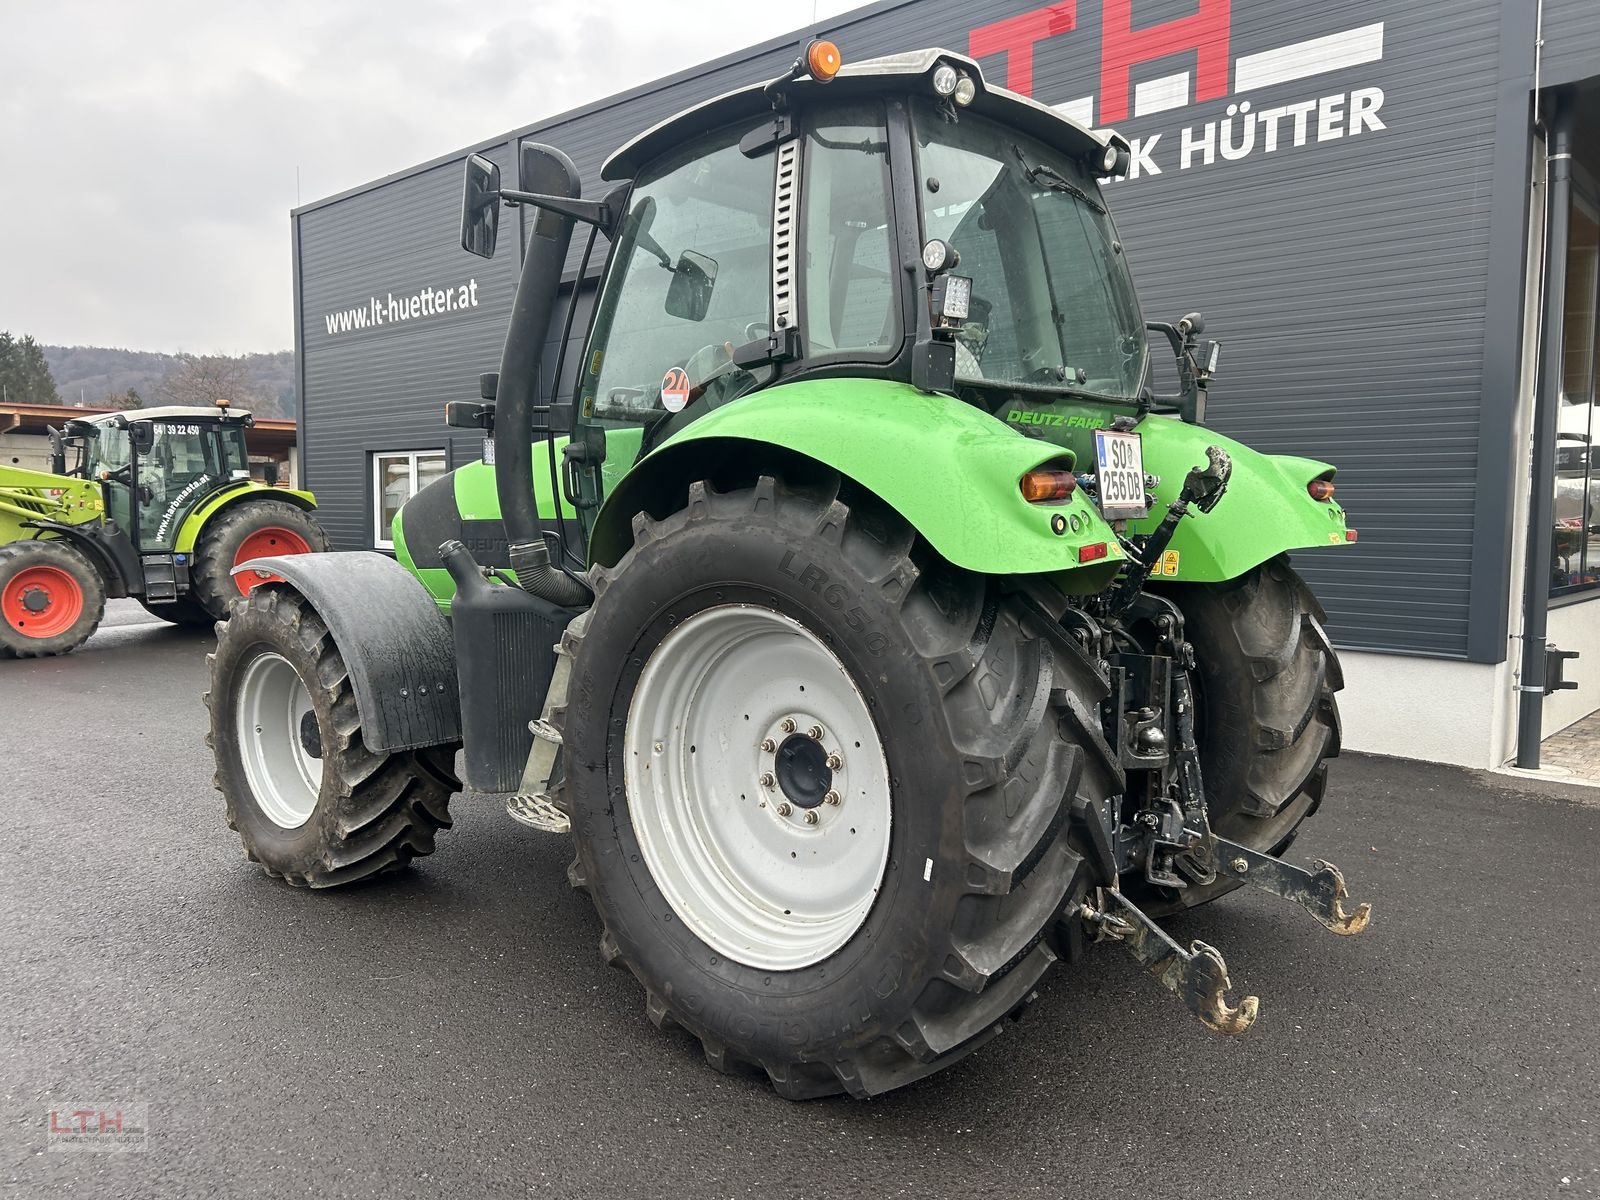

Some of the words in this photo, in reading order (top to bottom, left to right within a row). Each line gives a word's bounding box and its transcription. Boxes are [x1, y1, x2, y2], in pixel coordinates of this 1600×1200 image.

[1180, 87, 1388, 170] HÜTTER
[325, 278, 478, 335] www.lt-huetter.at
[167, 424, 176, 435] 39
[177, 424, 187, 435] 22
[187, 425, 200, 436] 450
[1111, 439, 1127, 469] SO
[155, 473, 211, 542] www.harbmasta.at
[777, 551, 891, 657] LR650
